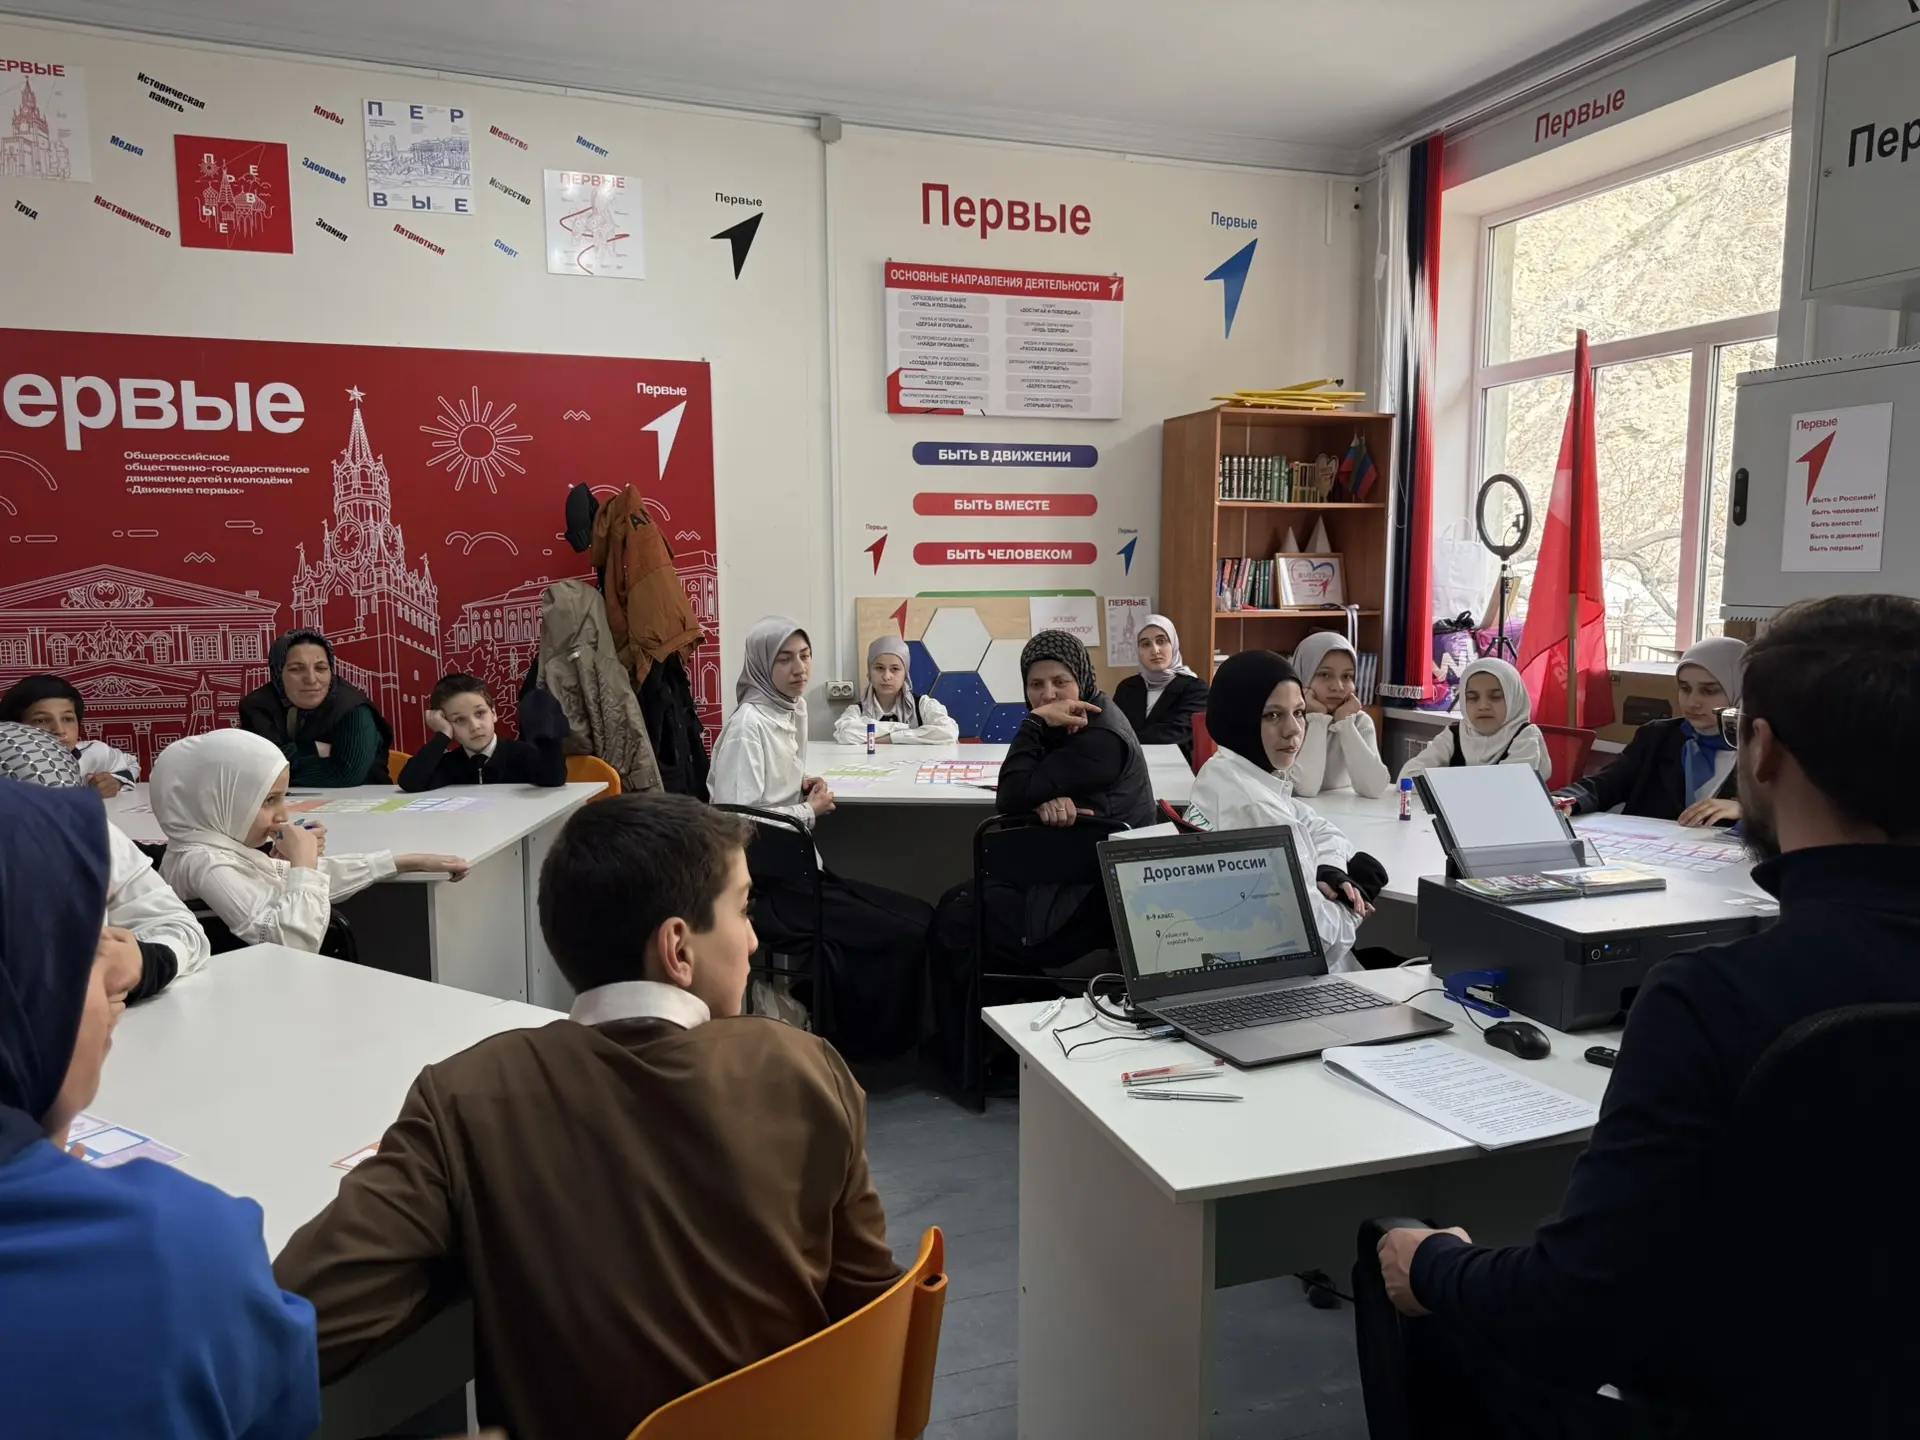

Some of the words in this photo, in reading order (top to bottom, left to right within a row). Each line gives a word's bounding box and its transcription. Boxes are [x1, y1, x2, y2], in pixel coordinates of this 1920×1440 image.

[137, 72, 205, 110] Историческая
[149, 91, 184, 113] память
[313, 105, 344, 126] Клубы
[1535, 88, 1626, 143] Первые
[110, 135, 144, 156] Медиа
[489, 125, 528, 150] Шефство
[576, 135, 609, 158] Контент
[1847, 117, 1920, 168] Пер
[302, 157, 347, 184] Здоровье
[489, 177, 531, 205] Искусство
[715, 192, 763, 207] Первые
[14, 200, 38, 220] Труд
[94, 195, 171, 238] Наставничество
[922, 182, 1091, 240] Первые
[1211, 211, 1258, 230] Первые
[316, 218, 348, 242] Знания
[393, 224, 446, 256] Патриотизм
[494, 239, 518, 258] Спорт
[890, 268, 948, 284] ОСНОВНЫЕ
[951, 273, 1022, 288] НАПРАВЛЕНИЯ
[1025, 278, 1100, 292] ДЕЯТЕЛЬНОСТИ
[637, 382, 687, 398] Первые
[3, 373, 305, 450] ервые
[1797, 418, 1838, 432] Первые
[124, 450, 230, 462] Общероссийское
[938, 449, 978, 461] БЫТЬ
[980, 450, 990, 461] В
[992, 450, 1072, 463] ДВИЖЕНИИ
[124, 464, 310, 476] общественно-государственное
[125, 474, 186, 485] движение
[188, 474, 220, 486] детей
[233, 474, 293, 486] молодёжи
[126, 485, 193, 496] «Движение
[196, 486, 244, 497] первых»
[1839, 494, 1876, 502] Россией!
[954, 499, 993, 510] БЫТЬ
[995, 500, 1050, 511] ВМЕСТЕ
[1832, 506, 1878, 514] человеком!
[946, 548, 985, 560] БЫТЬ
[987, 549, 1072, 560] ЧЕЛОВЕКОМ
[1108, 599, 1147, 607] ПЕРВЫЕ
[1143, 863, 1215, 883] Дорогами
[1218, 856, 1267, 873] России
